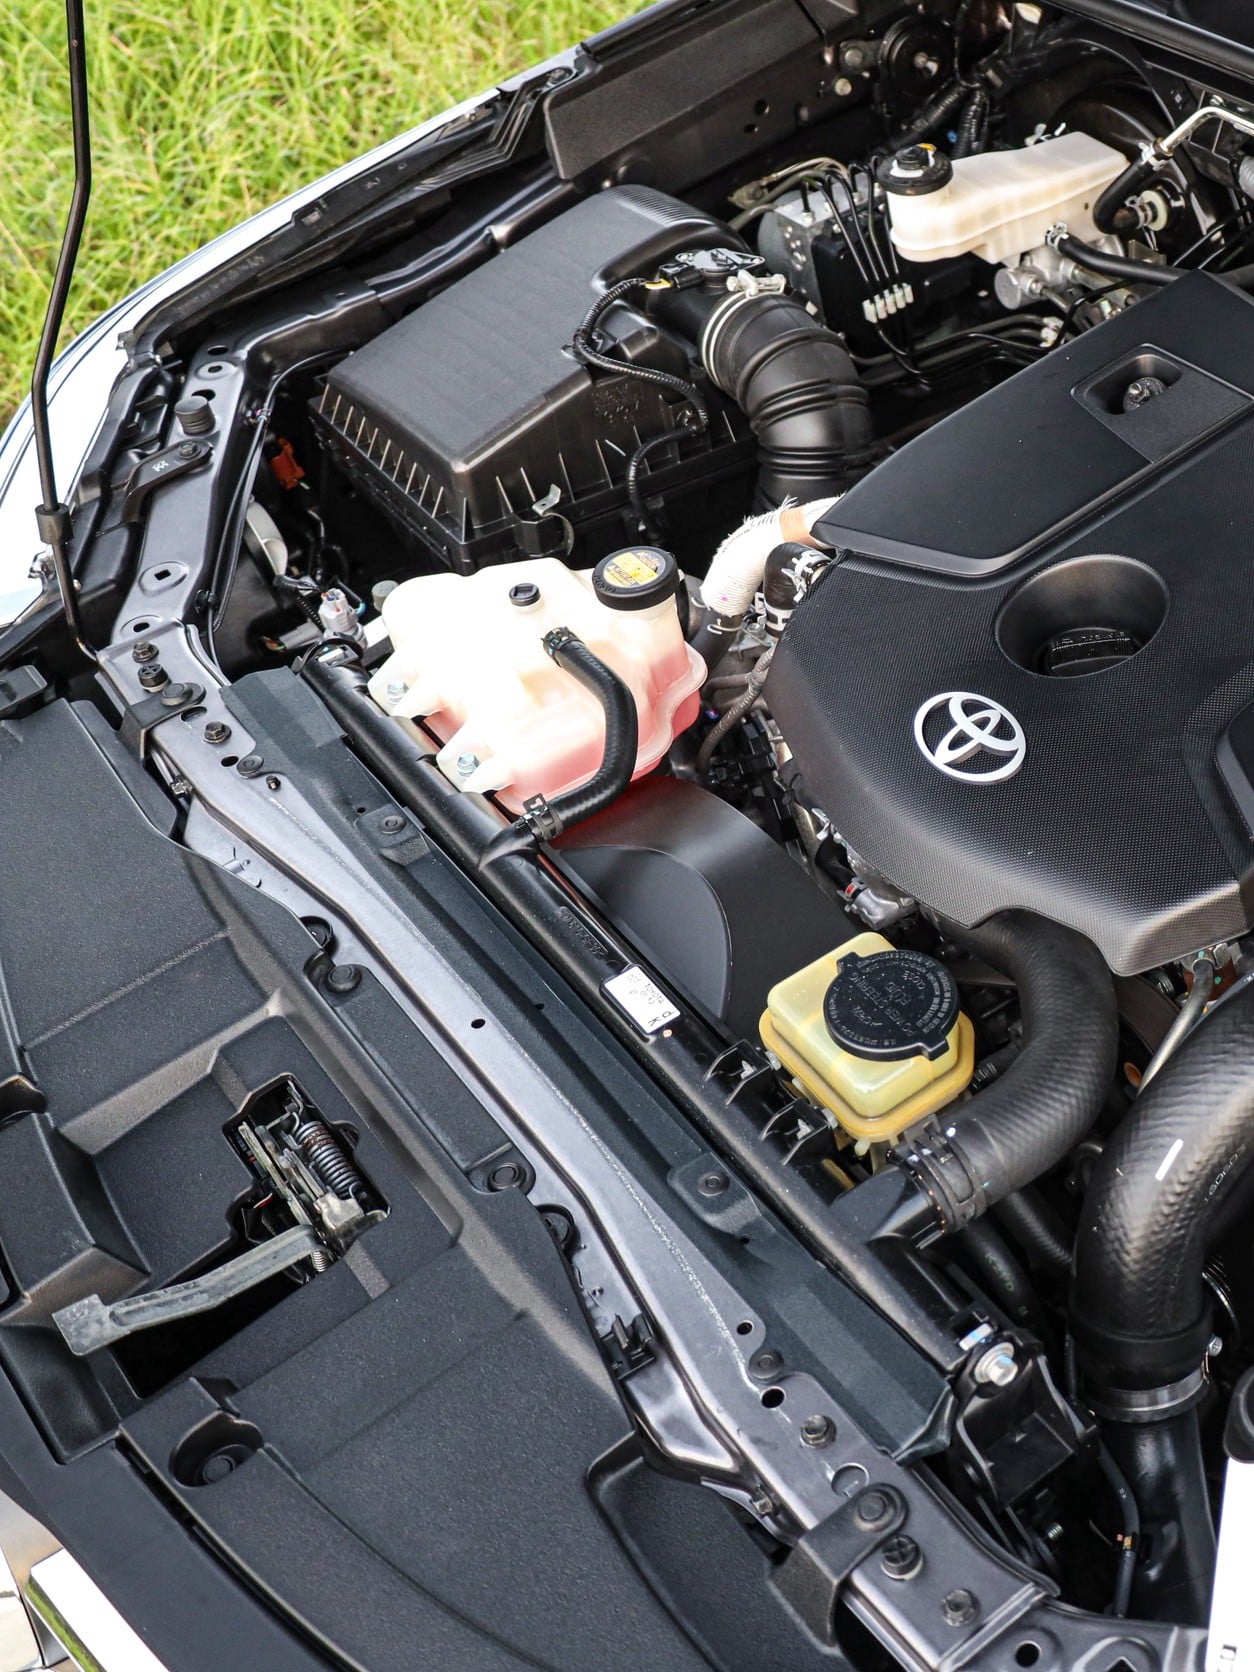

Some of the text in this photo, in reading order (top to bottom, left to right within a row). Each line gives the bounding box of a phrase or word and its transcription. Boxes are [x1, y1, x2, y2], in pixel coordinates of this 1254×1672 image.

[848, 971, 888, 1009] STEERING
[885, 981, 912, 1006] FLUID
[885, 1008, 915, 1037] POWER
